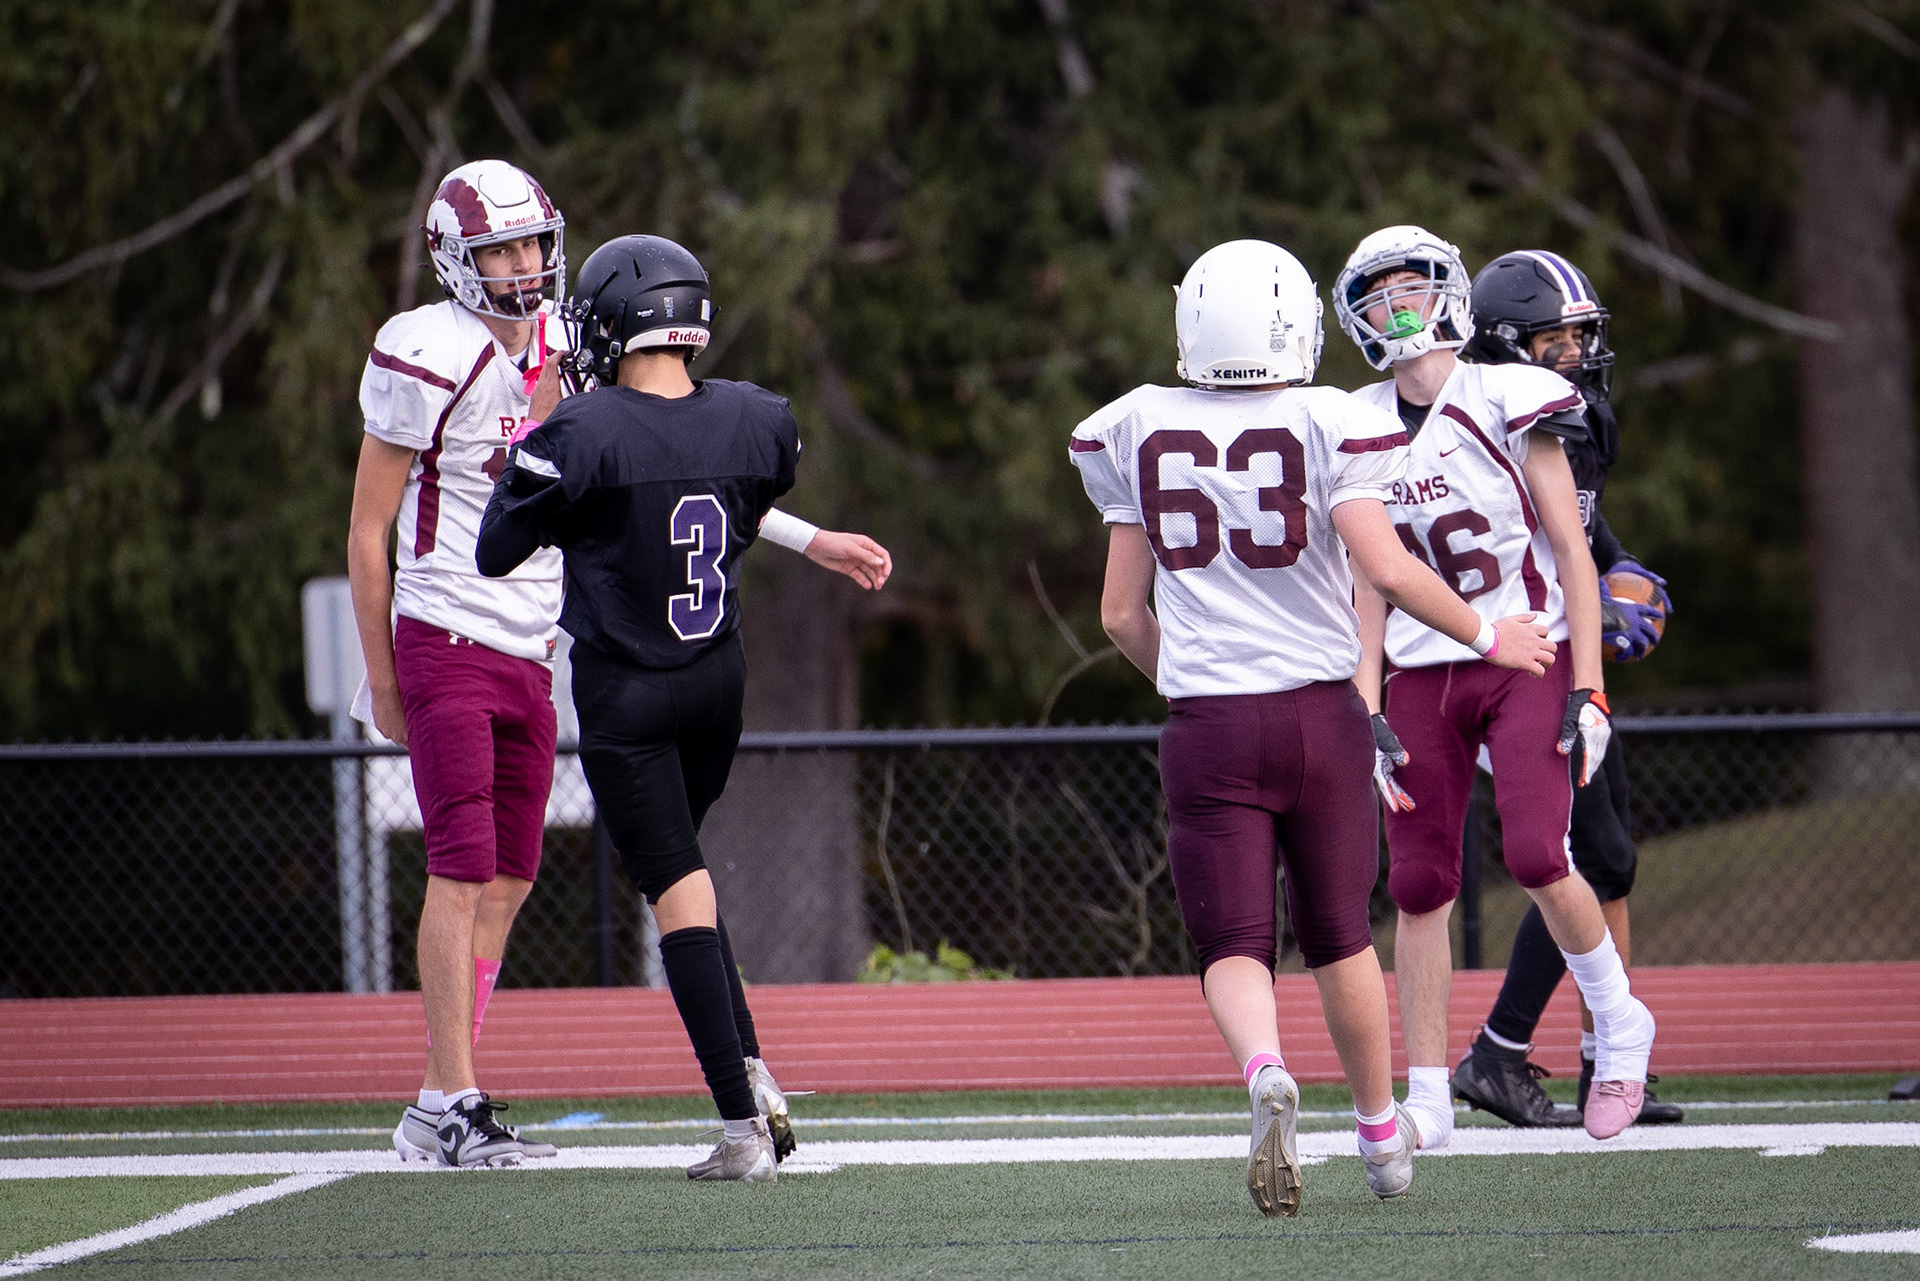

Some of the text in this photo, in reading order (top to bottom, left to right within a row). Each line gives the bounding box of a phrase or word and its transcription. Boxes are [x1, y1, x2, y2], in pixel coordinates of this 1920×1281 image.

[505, 214, 536, 227] Riddell
[1212, 368, 1267, 379] XENITH
[1138, 427, 1308, 571] 63
[1392, 475, 1450, 505] RAMS
[668, 494, 727, 640] 3
